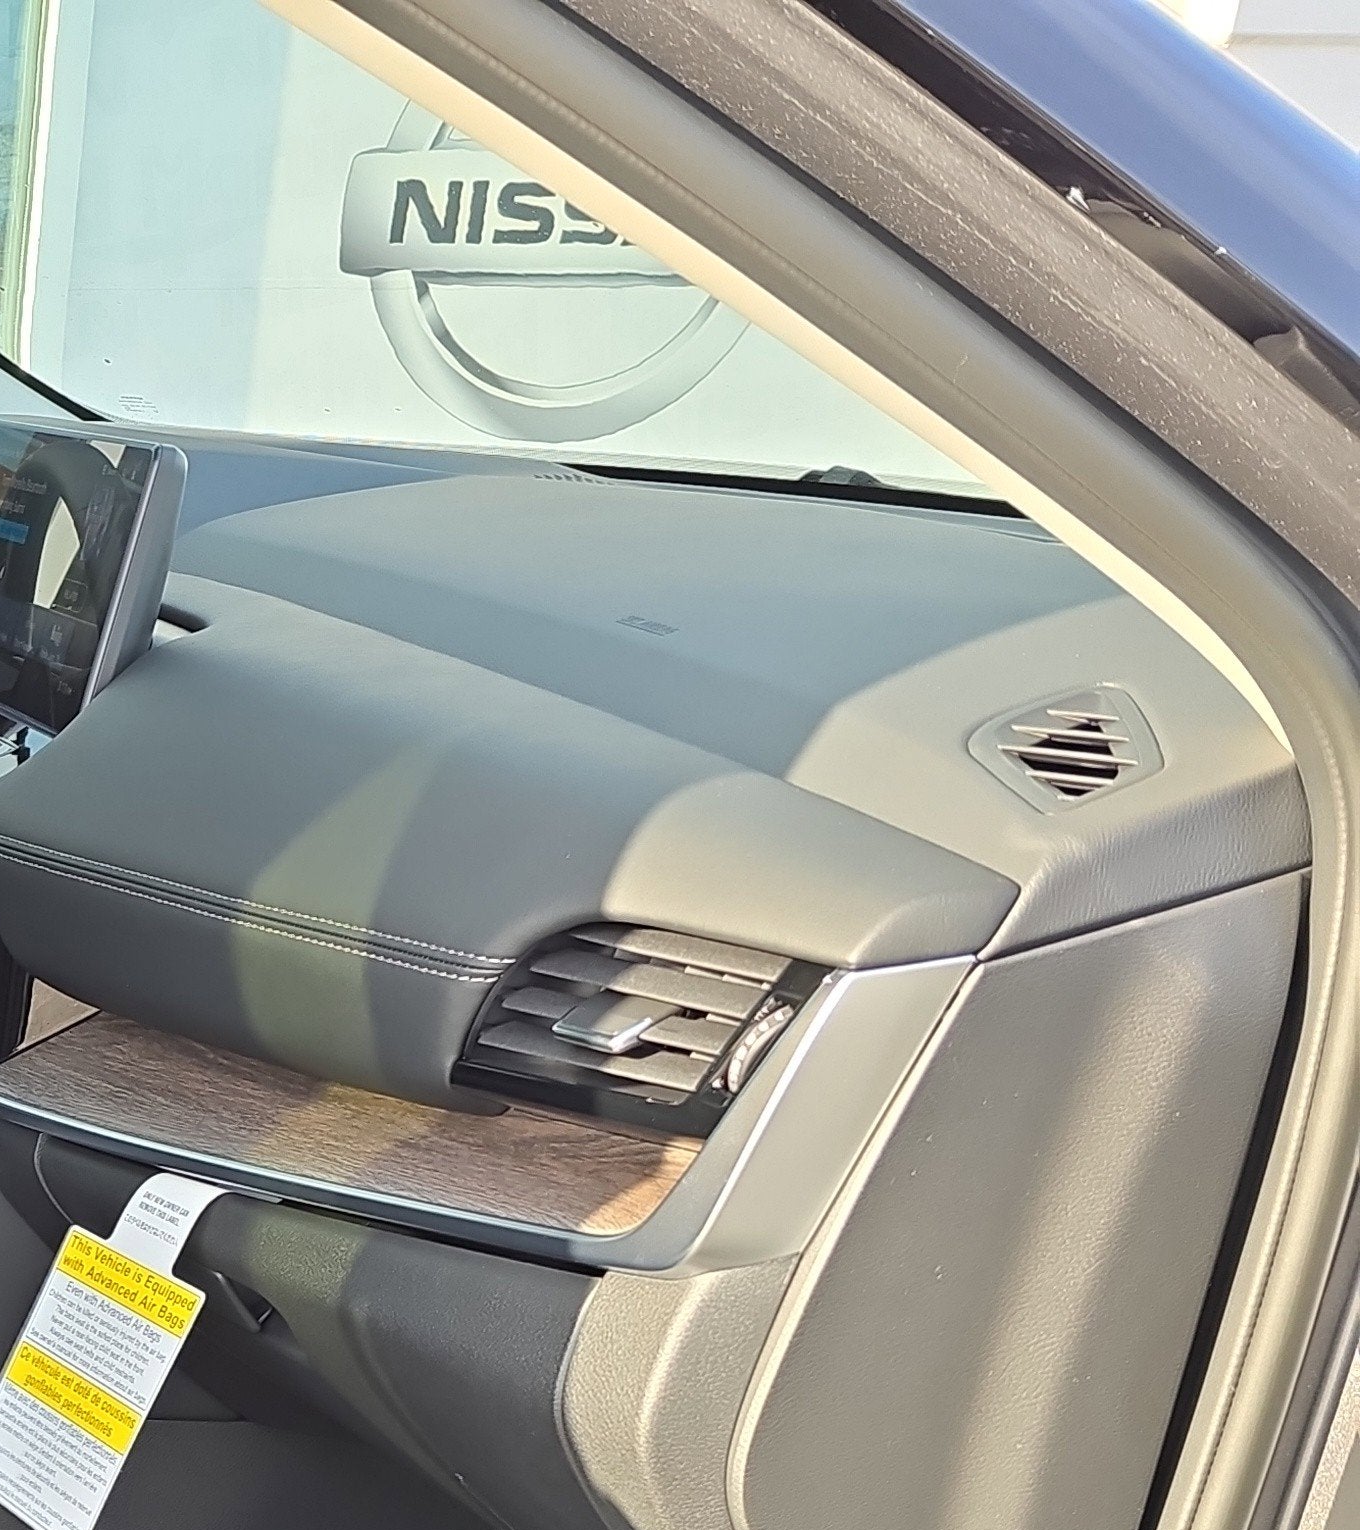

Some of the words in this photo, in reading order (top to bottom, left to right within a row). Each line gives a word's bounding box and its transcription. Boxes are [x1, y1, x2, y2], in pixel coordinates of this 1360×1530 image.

[63, 1255, 84, 1274] with
[86, 1266, 138, 1302] Advanced
[138, 1295, 156, 1312] Air
[158, 1305, 185, 1329] Bags
[71, 1235, 92, 1256] This
[95, 1247, 130, 1276] Vehicle
[132, 1268, 142, 1283] is
[144, 1275, 197, 1311] Equipped
[20, 1347, 31, 1361] Ce
[32, 1356, 60, 1380] véhicule
[61, 1375, 74, 1388] est
[73, 1381, 92, 1399] doté
[90, 1392, 101, 1406] de
[101, 1401, 136, 1429] coussins
